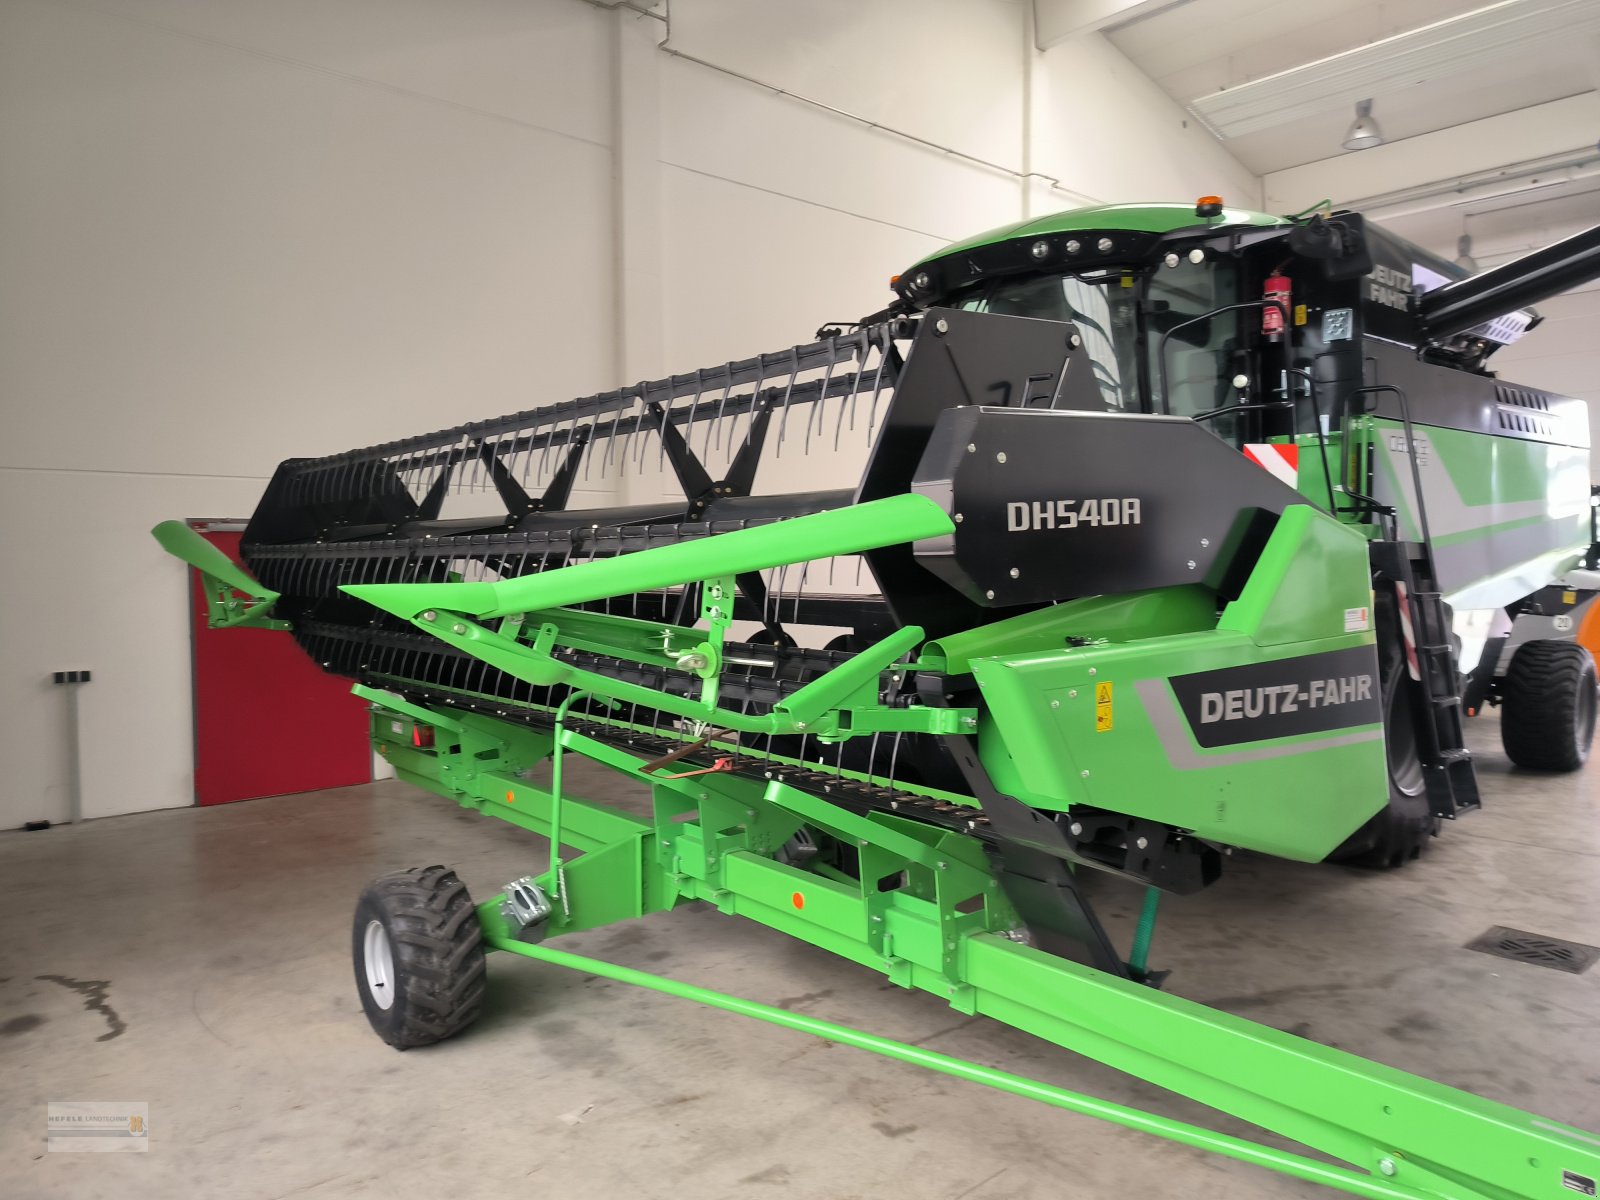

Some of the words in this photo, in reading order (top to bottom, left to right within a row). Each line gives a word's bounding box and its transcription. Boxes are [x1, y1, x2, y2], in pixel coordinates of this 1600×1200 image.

[1371, 284, 1408, 312] FAHR
[1007, 498, 1141, 532] DH540A
[1200, 674, 1372, 724] DEUTZ-FAHR
